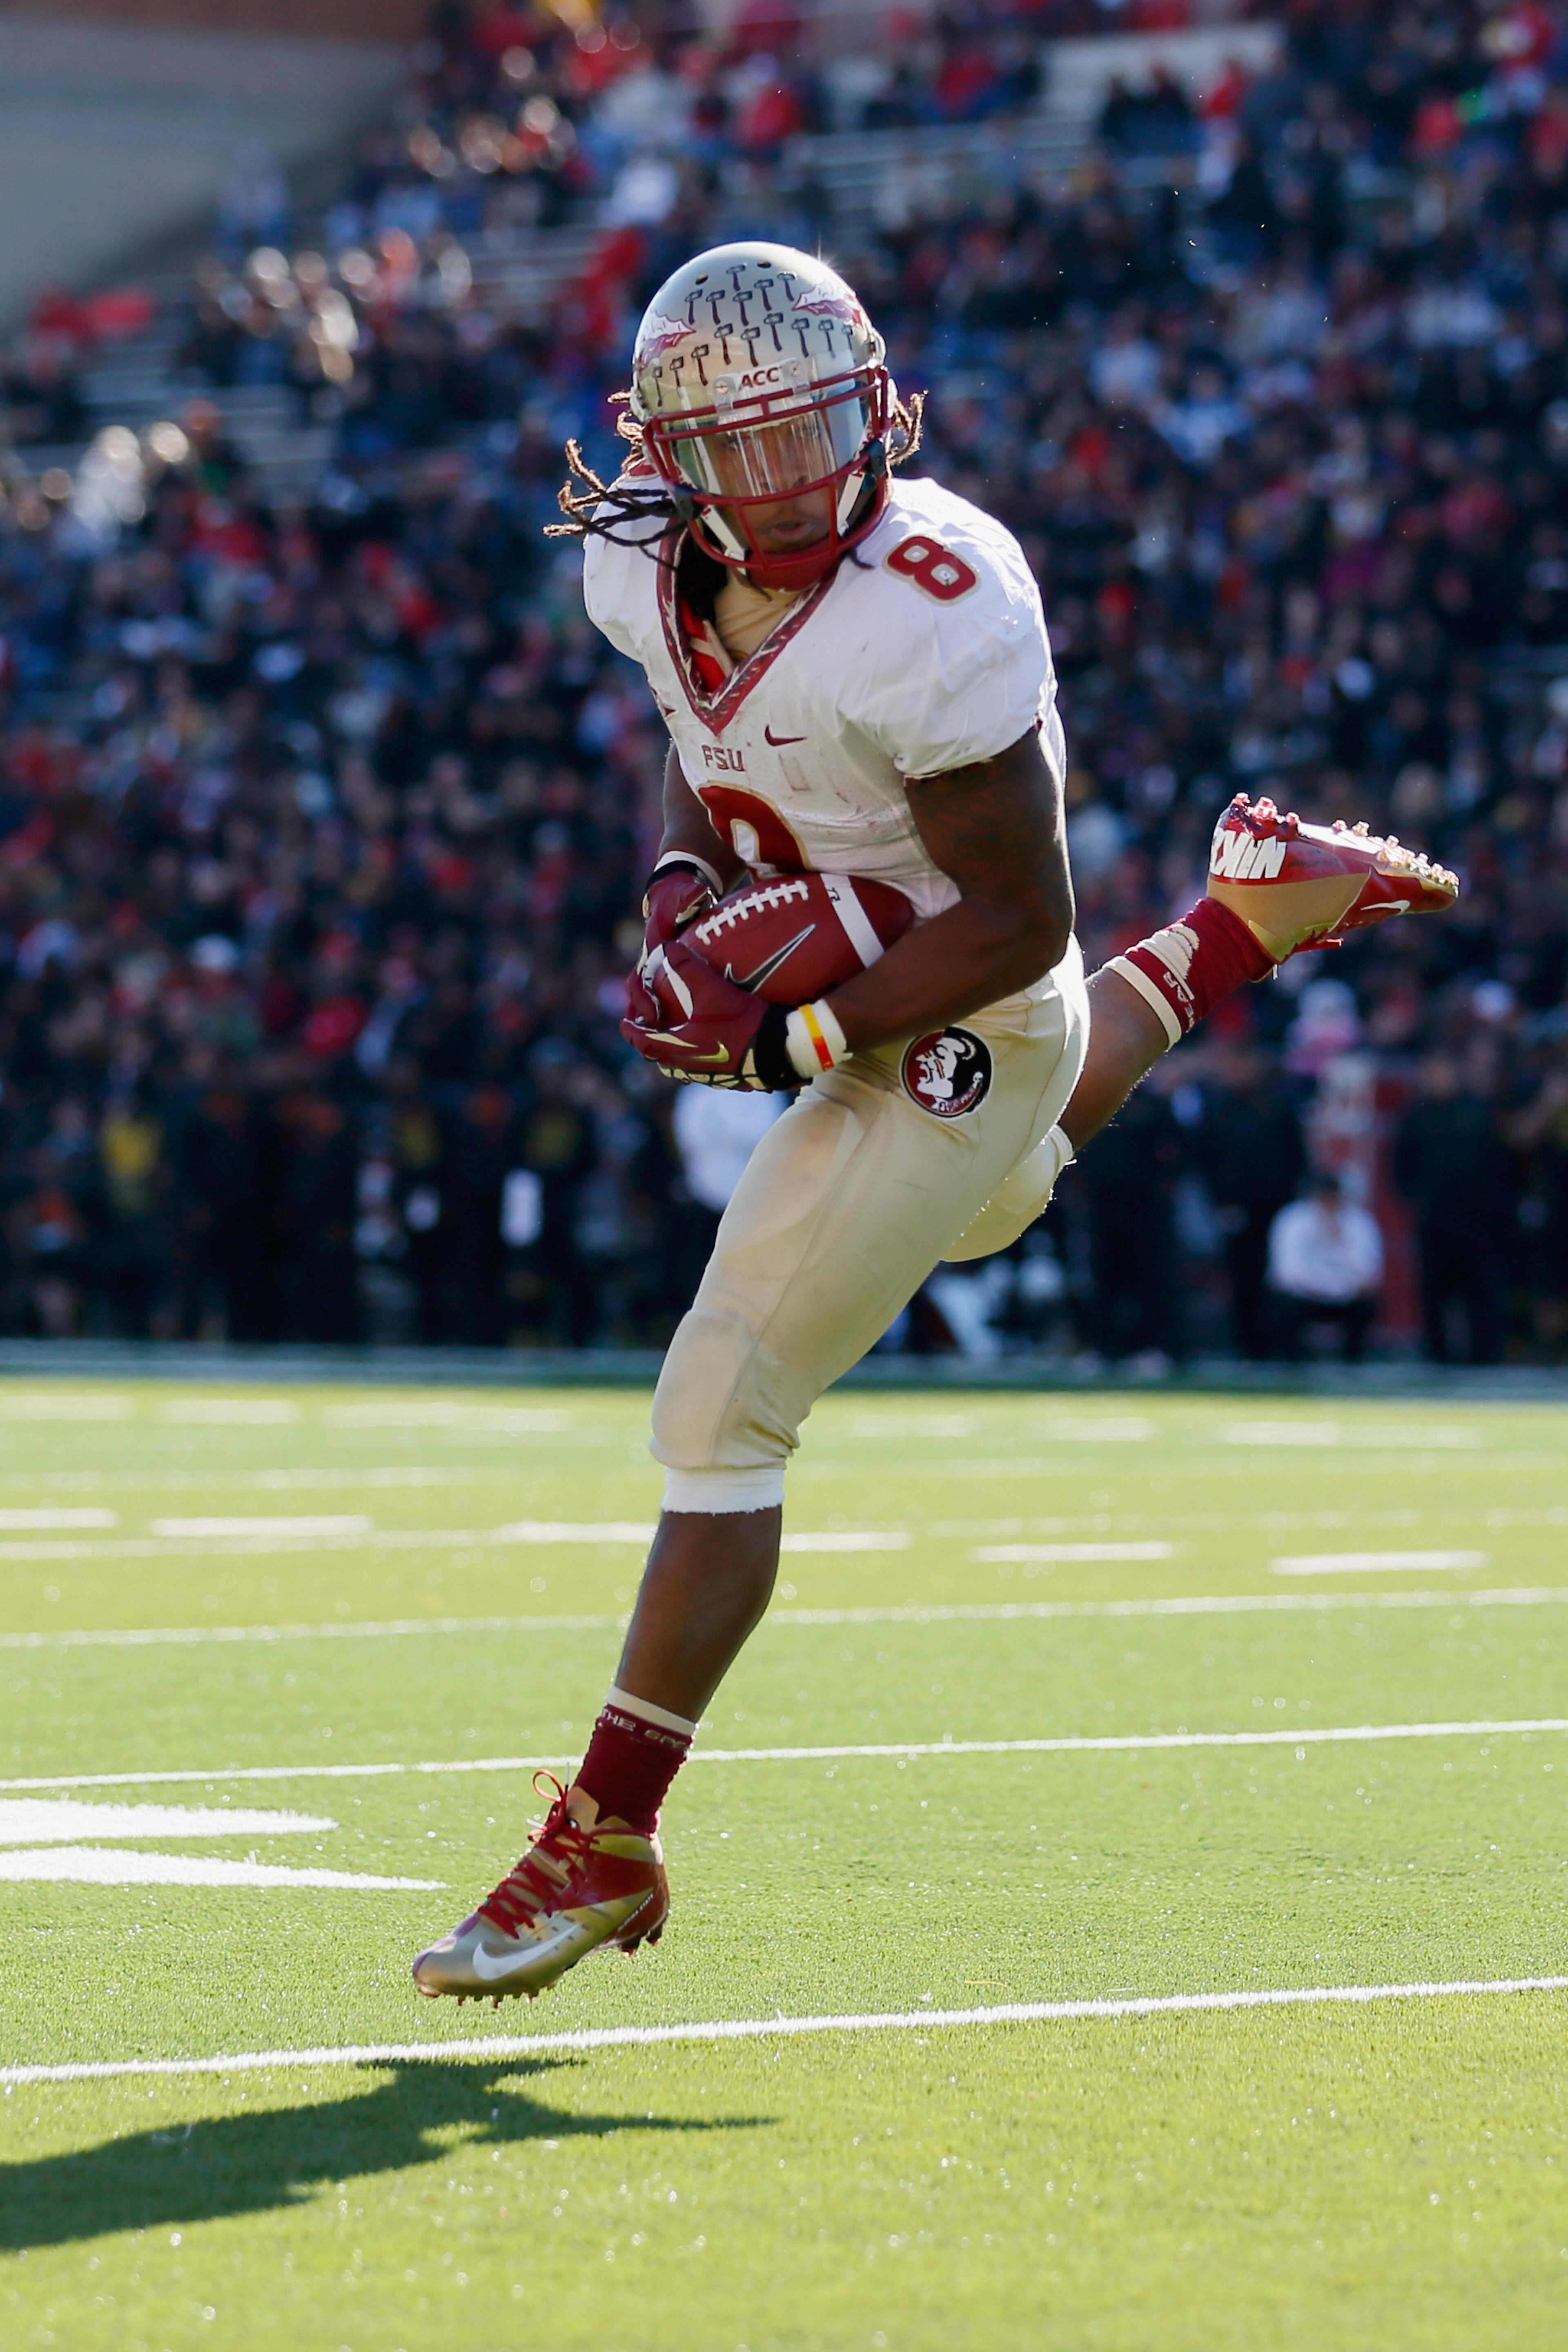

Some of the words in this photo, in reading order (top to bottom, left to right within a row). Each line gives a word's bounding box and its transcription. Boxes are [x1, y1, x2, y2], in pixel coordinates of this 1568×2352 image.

[738, 367, 780, 391] ACC
[882, 534, 981, 606] 8
[701, 745, 745, 771] FSU
[1163, 971, 1195, 1033] PEAR
[601, 1708, 636, 1732] THE
